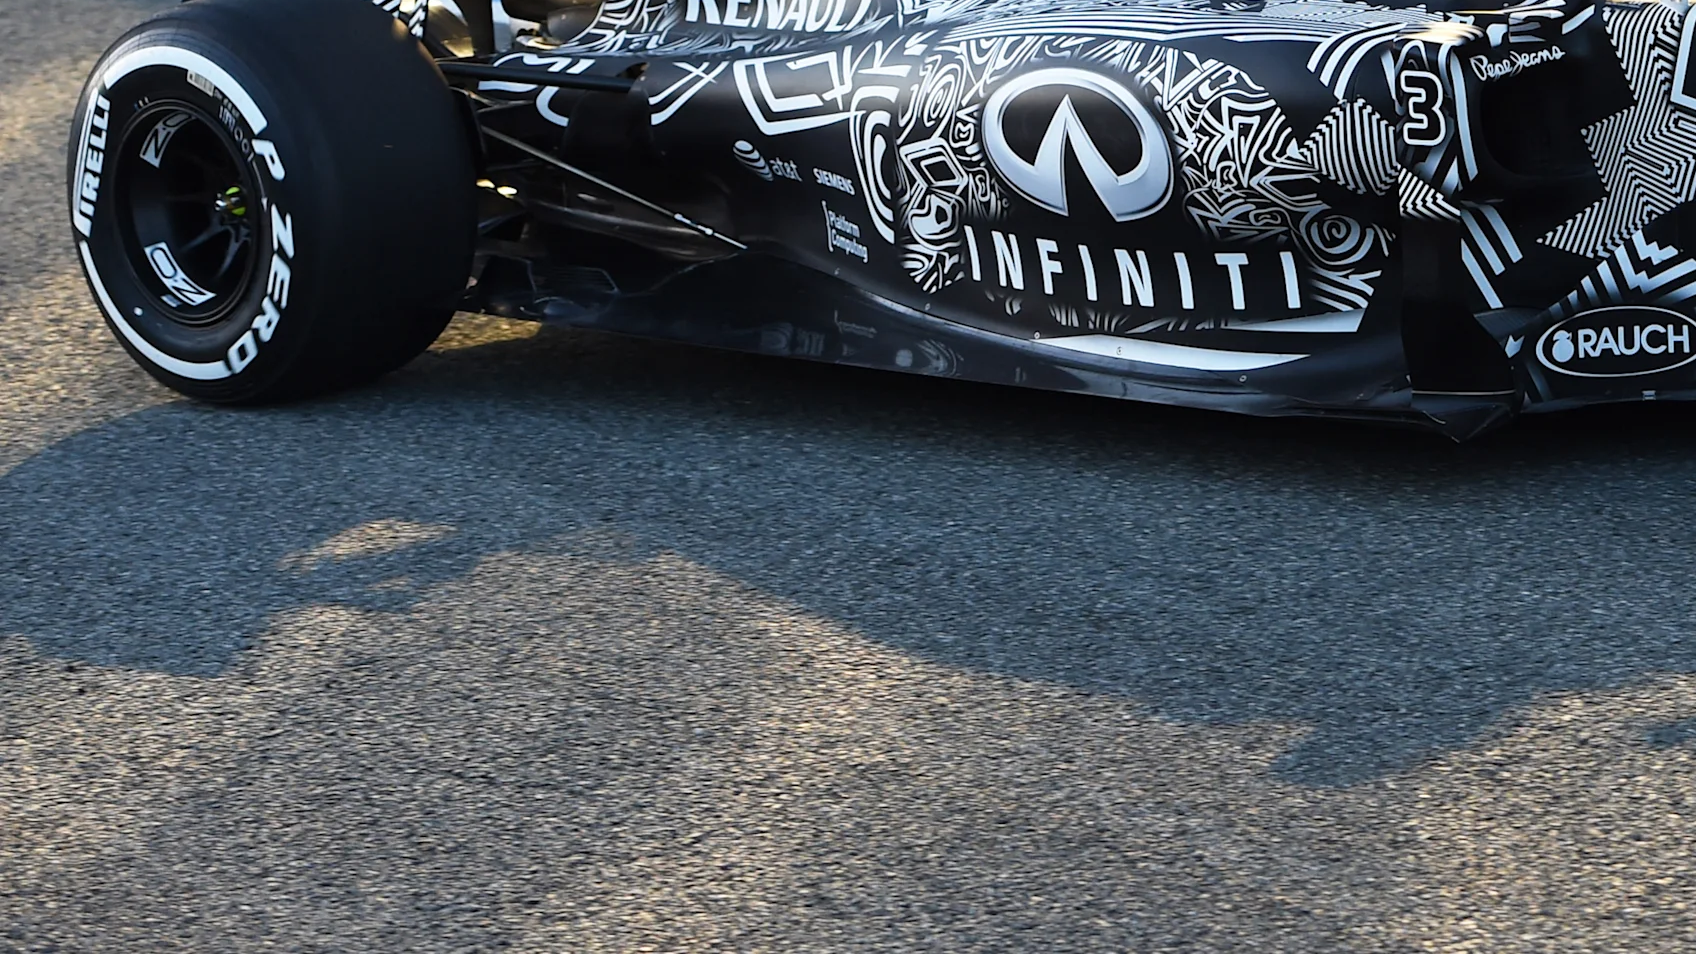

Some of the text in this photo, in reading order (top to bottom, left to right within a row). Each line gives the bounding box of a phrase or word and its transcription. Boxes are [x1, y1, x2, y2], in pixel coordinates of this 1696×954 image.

[1400, 70, 1446, 146] 3
[74, 87, 111, 238] PIRELLI
[812, 167, 856, 195] SIEMENS
[828, 210, 861, 238] Platform
[831, 229, 869, 263] Computing
[226, 205, 294, 374] ZERO
[963, 225, 1302, 310] INFINITI
[1577, 323, 1691, 359] RAUCH
